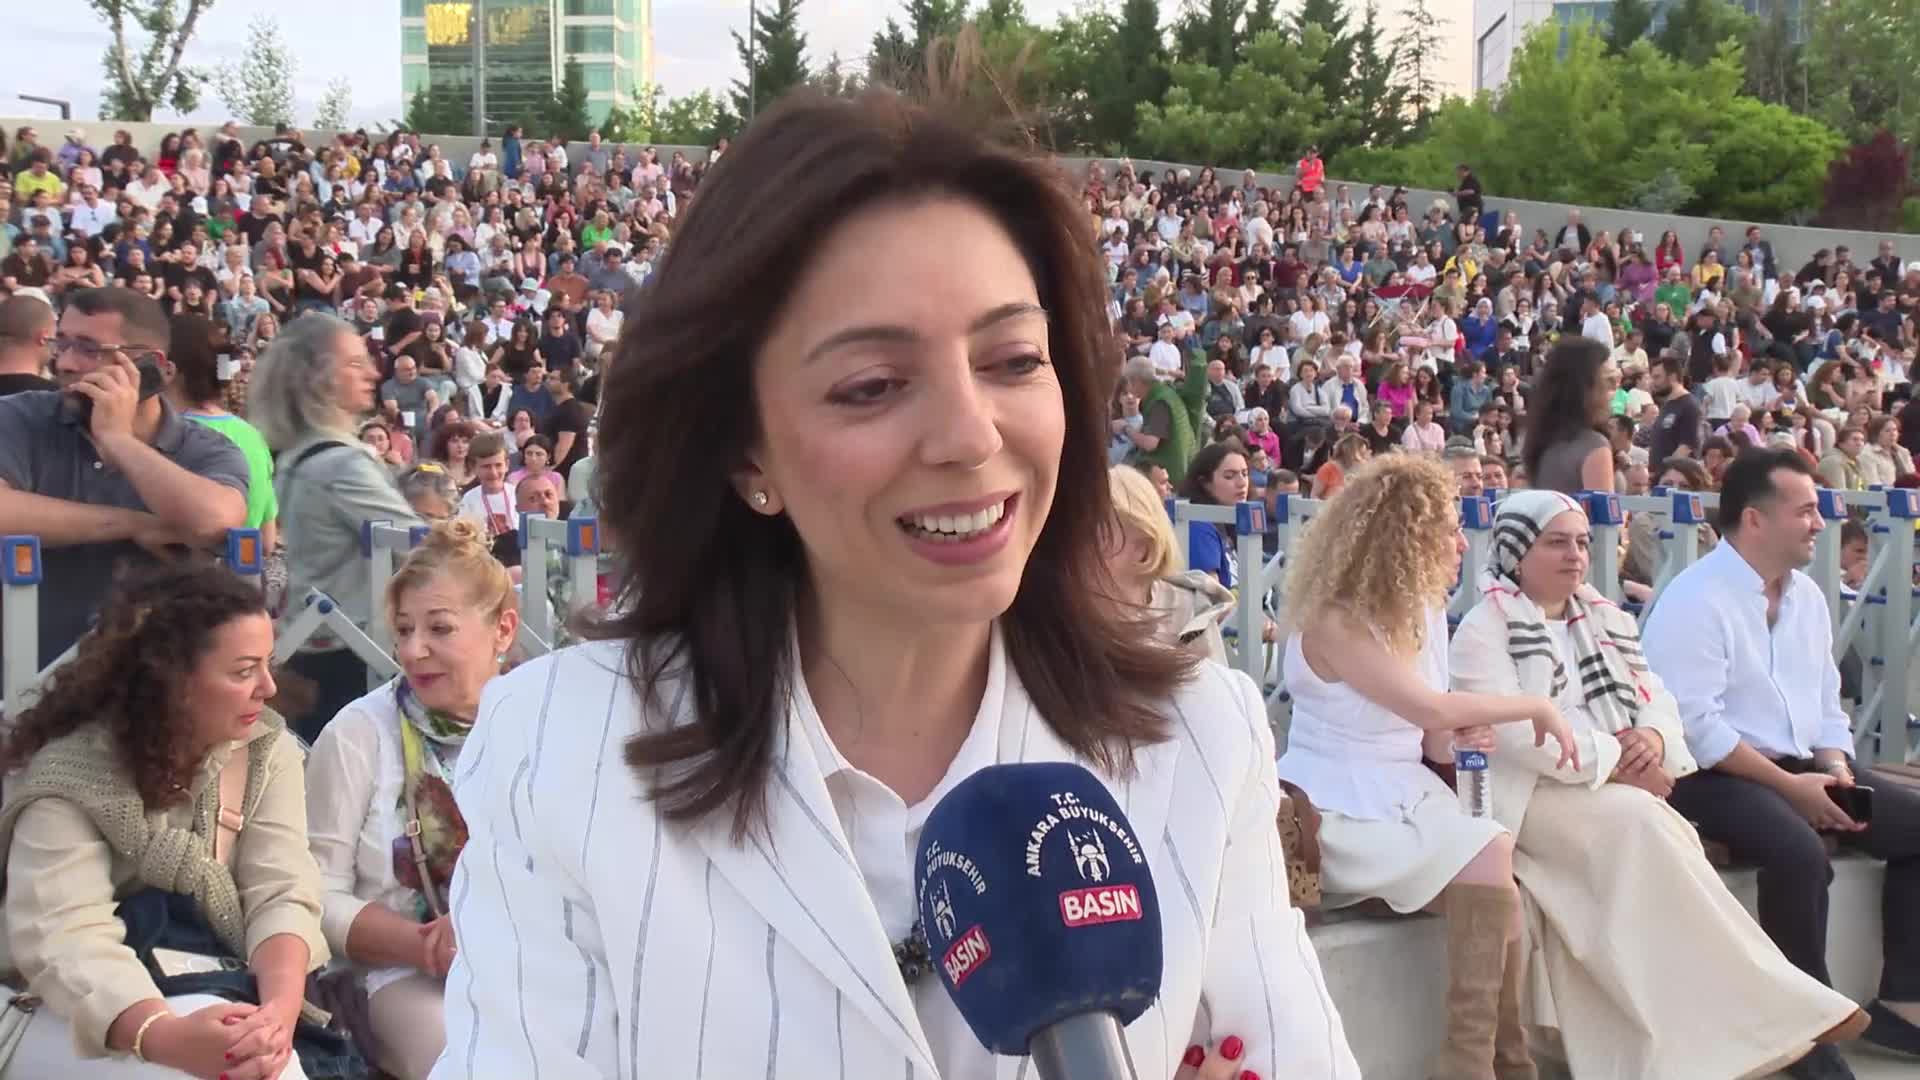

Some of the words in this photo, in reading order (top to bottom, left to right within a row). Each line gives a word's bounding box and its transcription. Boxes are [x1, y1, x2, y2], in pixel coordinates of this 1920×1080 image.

[1051, 792, 1080, 806] T.C.
[1026, 814, 1060, 877] ANKARA
[1064, 888, 1139, 921] BASIN
[944, 930, 987, 986] BASIN
